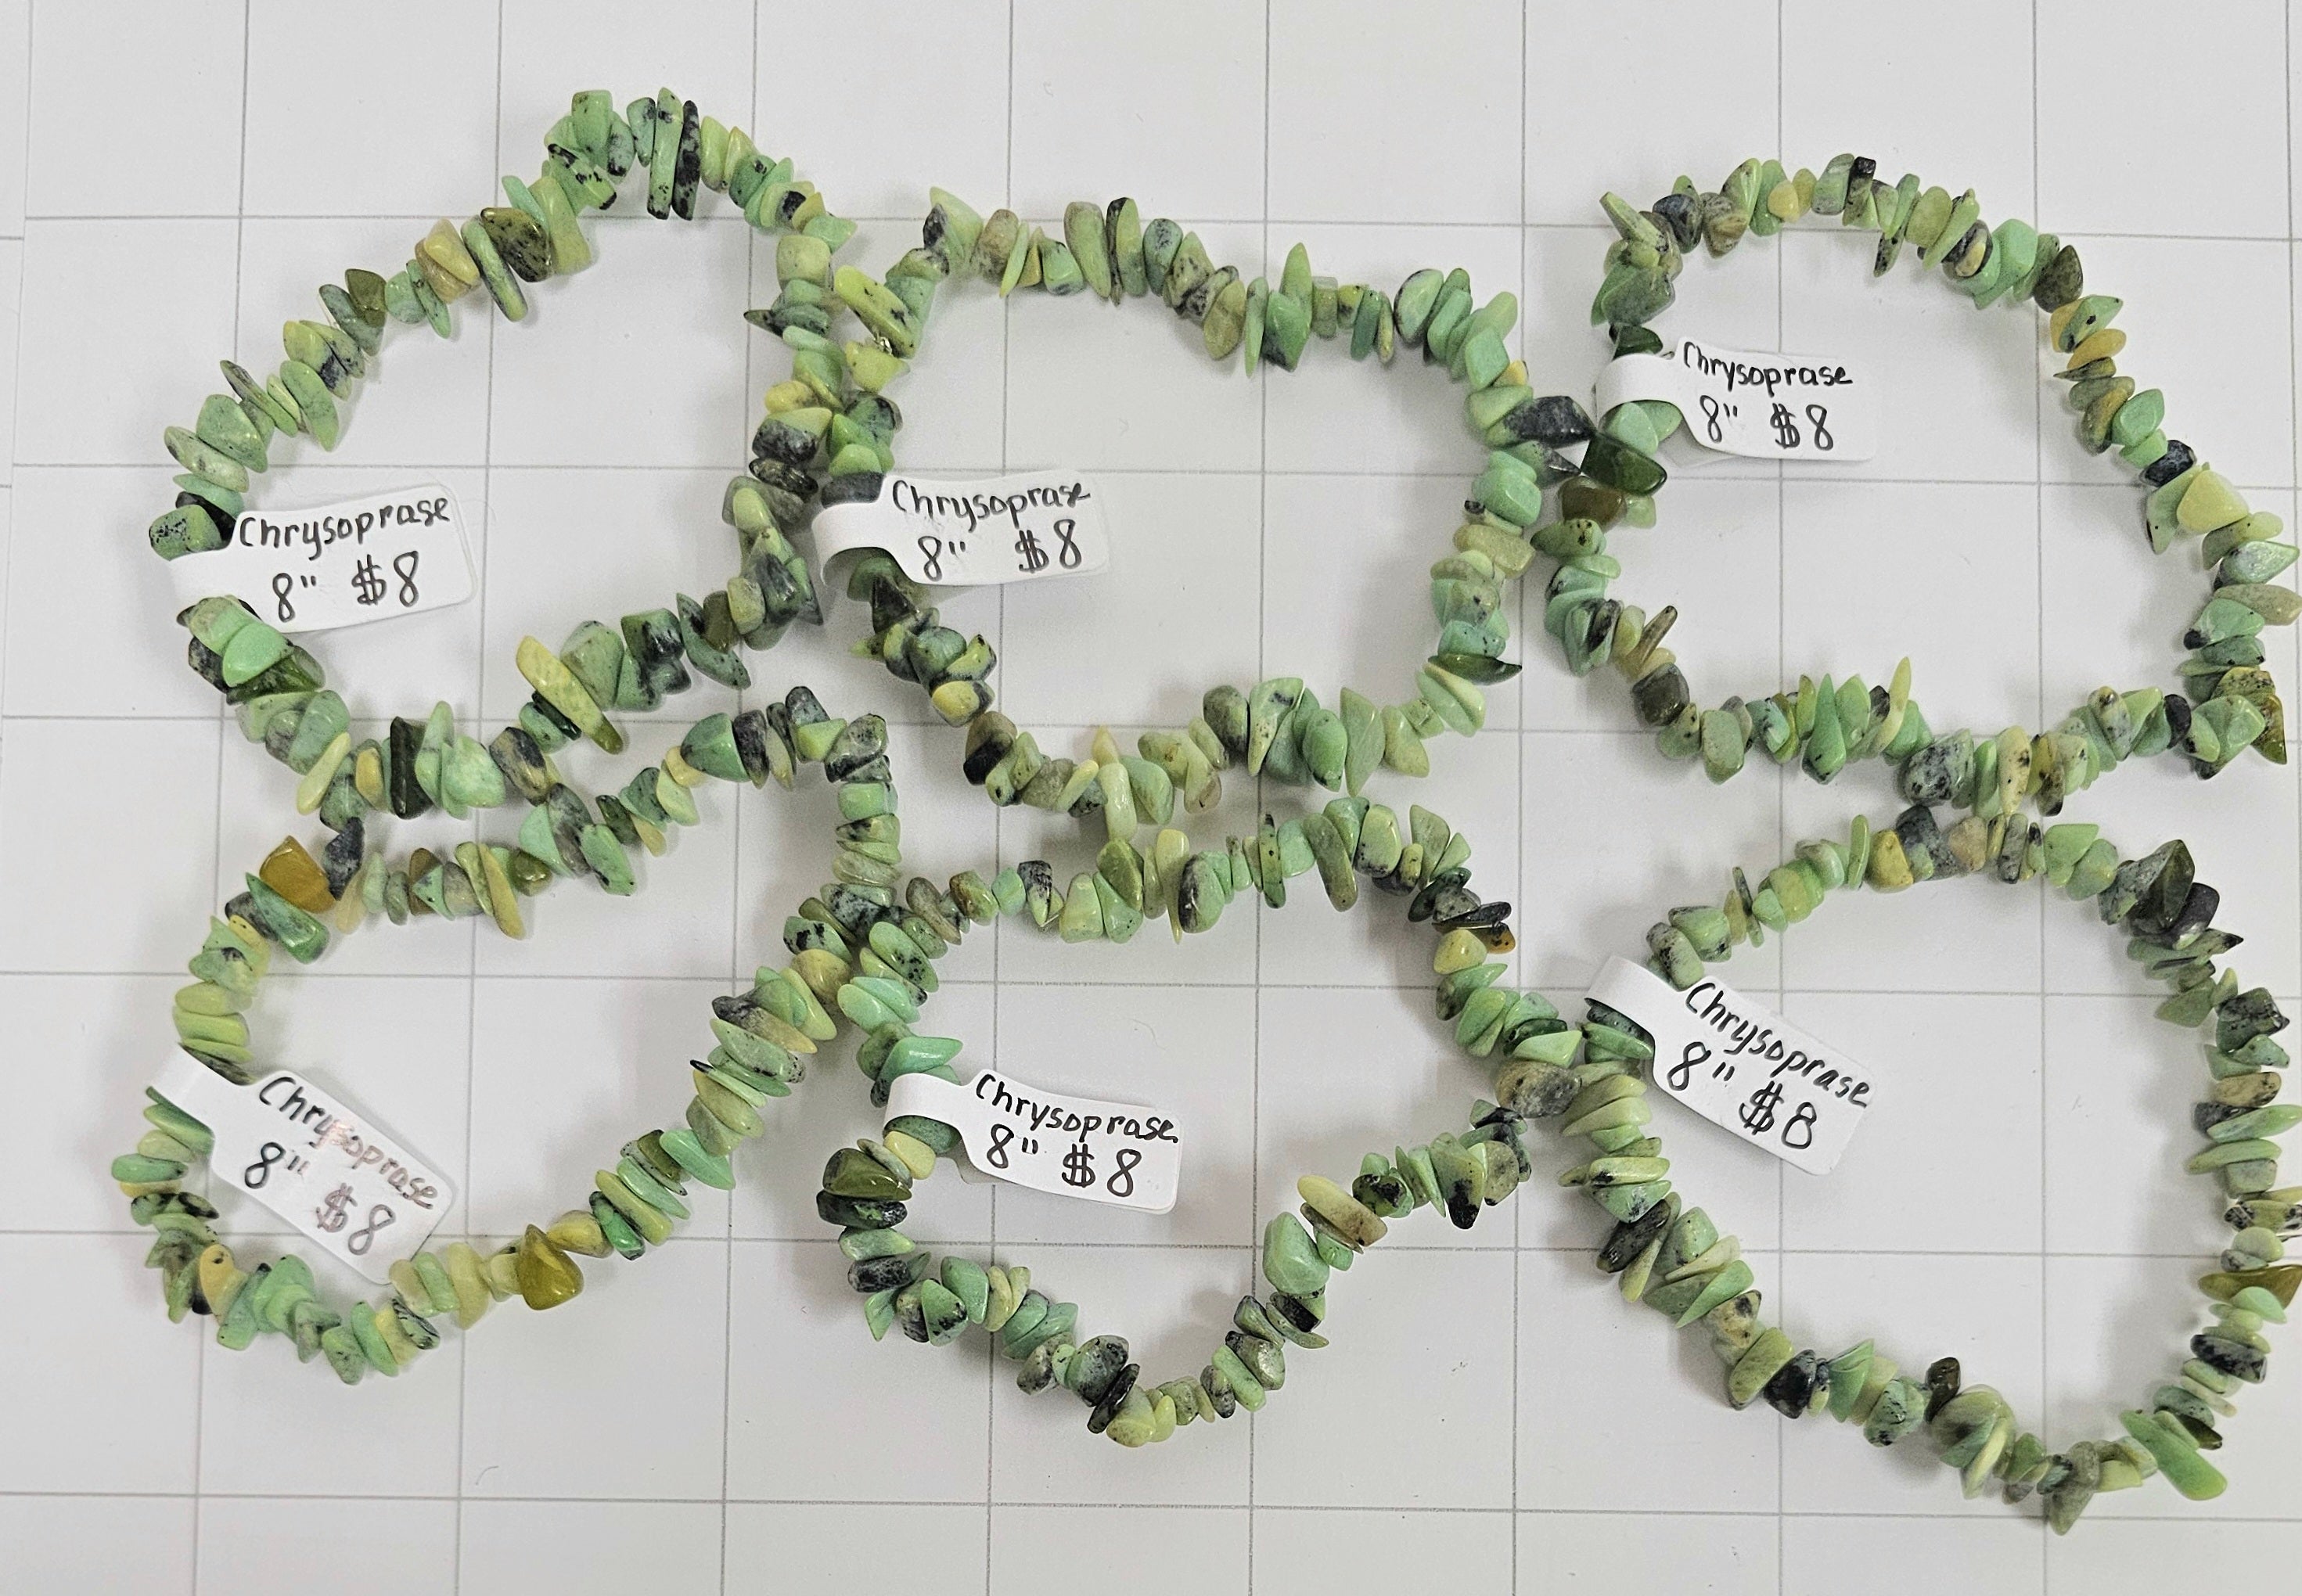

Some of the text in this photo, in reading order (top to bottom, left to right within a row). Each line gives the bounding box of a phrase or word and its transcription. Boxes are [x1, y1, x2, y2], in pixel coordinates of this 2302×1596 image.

[1683, 340, 1854, 399] Chrysoprase
[239, 497, 450, 562] Chrysoprase
[891, 479, 1092, 533] Chrysoprase
[1685, 980, 1871, 1109] Chrysoprase
[975, 1073, 1180, 1144] Chrysoprase
